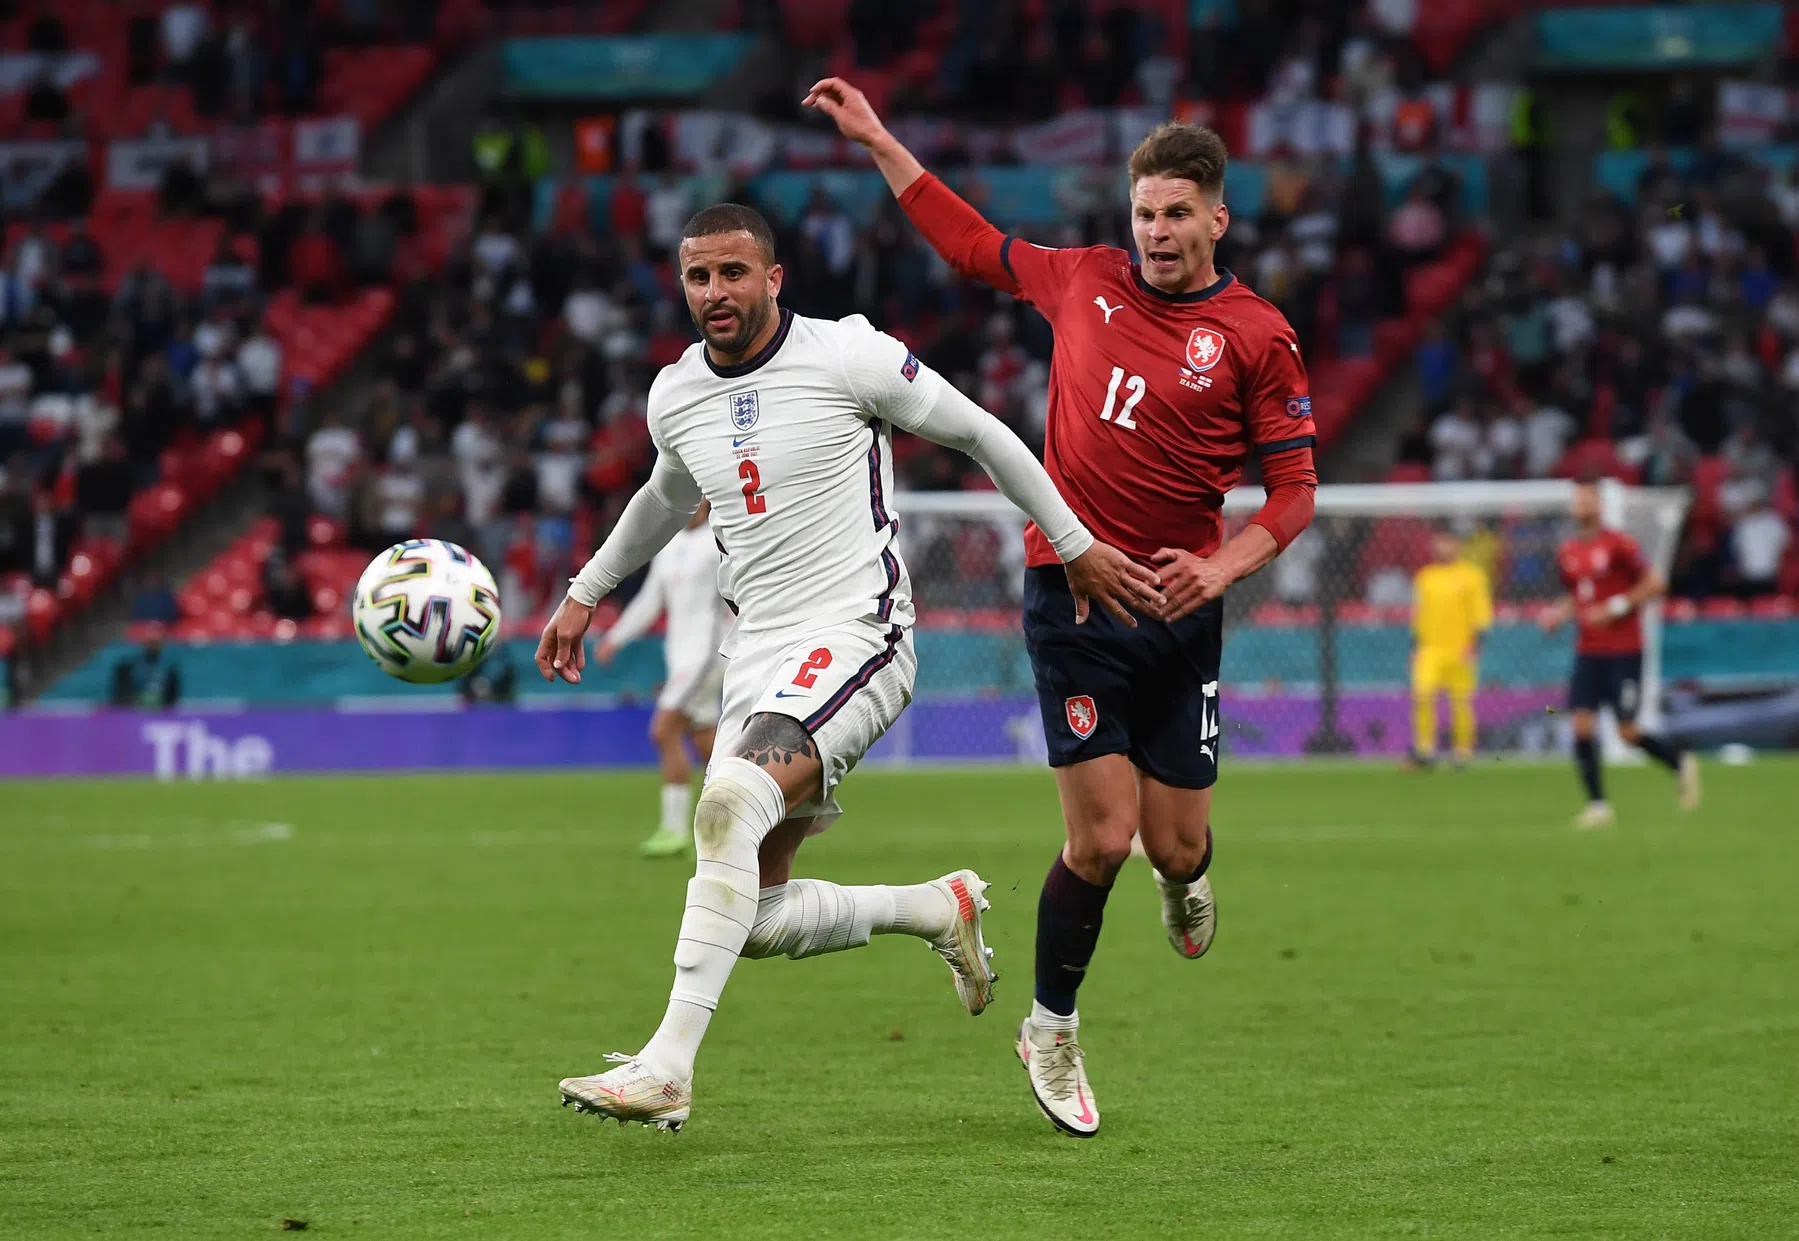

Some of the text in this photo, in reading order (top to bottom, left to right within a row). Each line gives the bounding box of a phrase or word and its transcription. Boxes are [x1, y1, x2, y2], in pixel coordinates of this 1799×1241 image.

[1100, 366, 1146, 430] 12
[738, 459, 766, 514] 2
[791, 647, 833, 689] 2
[142, 719, 276, 782] The
